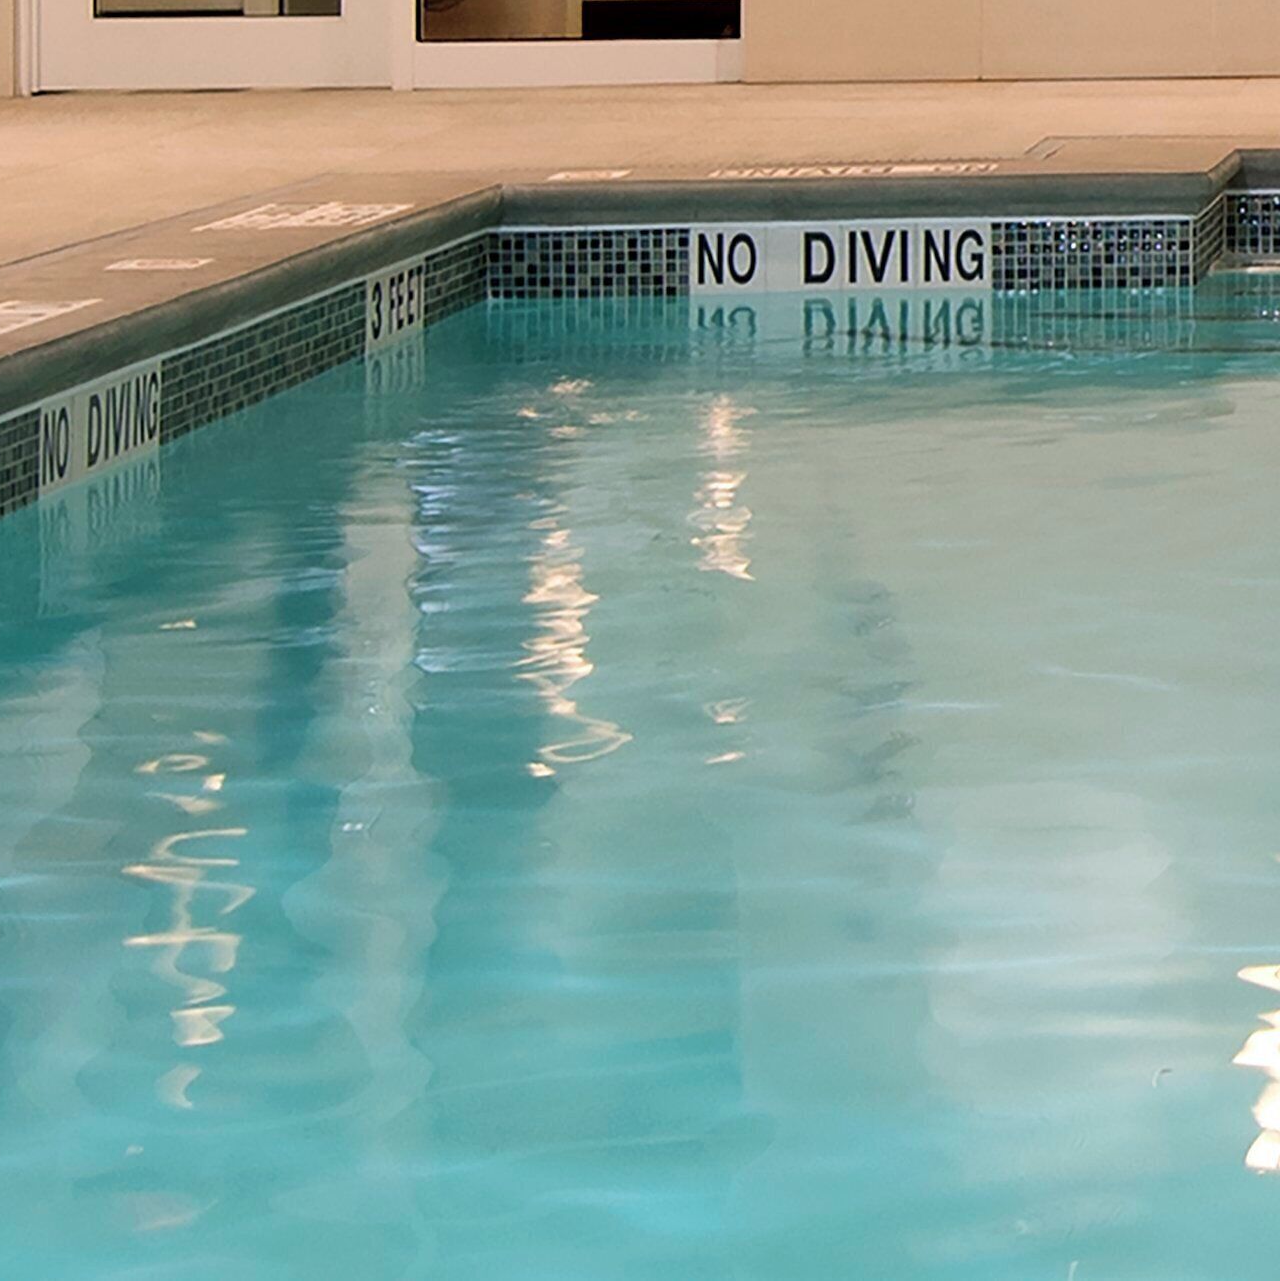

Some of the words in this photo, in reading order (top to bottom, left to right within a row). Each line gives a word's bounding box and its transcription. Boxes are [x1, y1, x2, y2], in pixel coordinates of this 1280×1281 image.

[697, 231, 757, 285] NO
[804, 229, 984, 284] DIVING
[372, 281, 382, 340] 3
[388, 265, 423, 335] FEET
[42, 406, 69, 486] NO
[87, 372, 159, 469] DIVING
